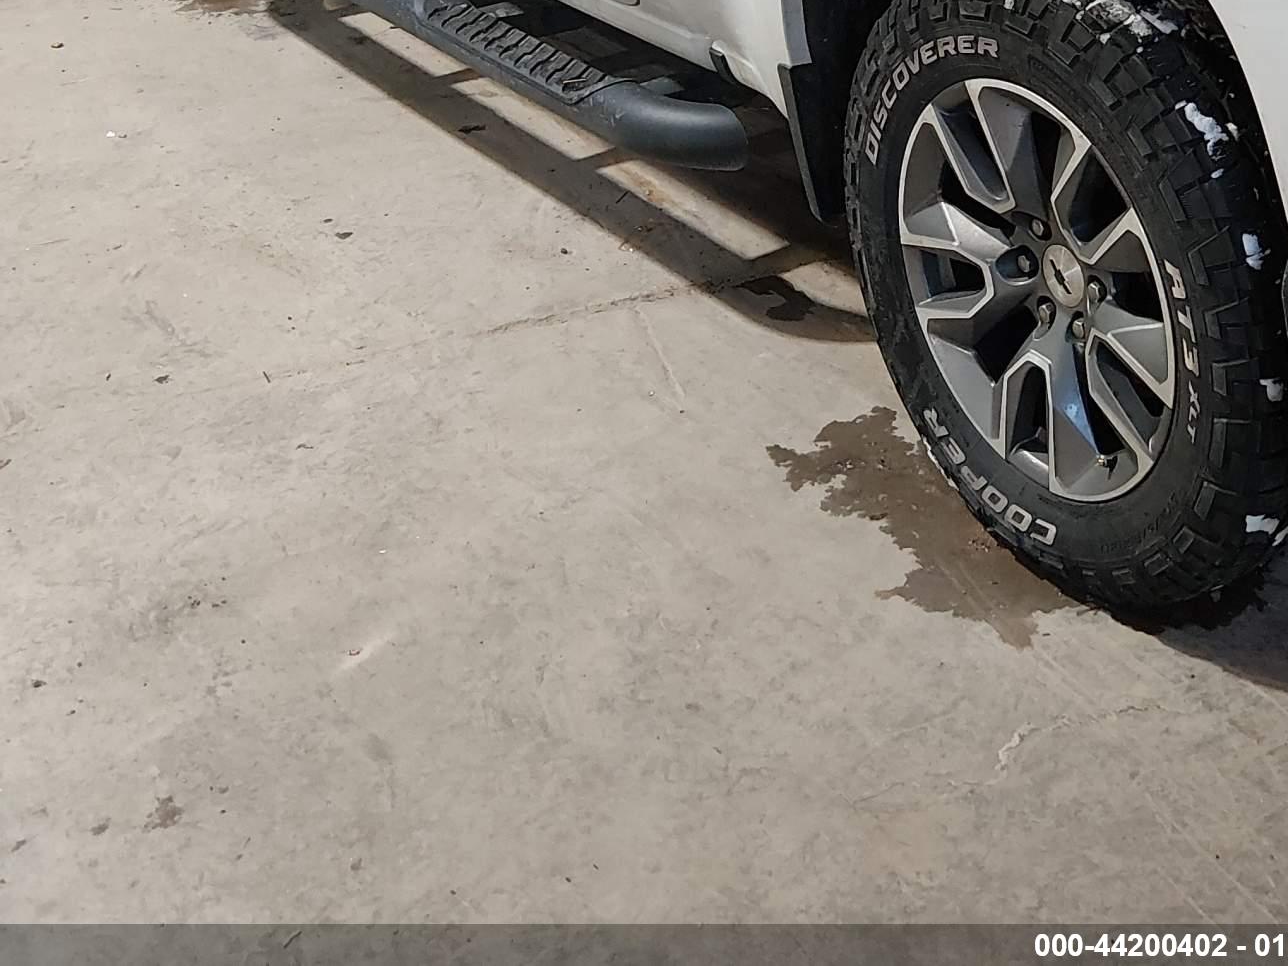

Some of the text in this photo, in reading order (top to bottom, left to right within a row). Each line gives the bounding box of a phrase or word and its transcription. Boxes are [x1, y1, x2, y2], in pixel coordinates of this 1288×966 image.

[865, 35, 999, 166] DISCOVERER
[1164, 259, 1201, 445] AT3 XLT
[923, 407, 1057, 546] COOPER
